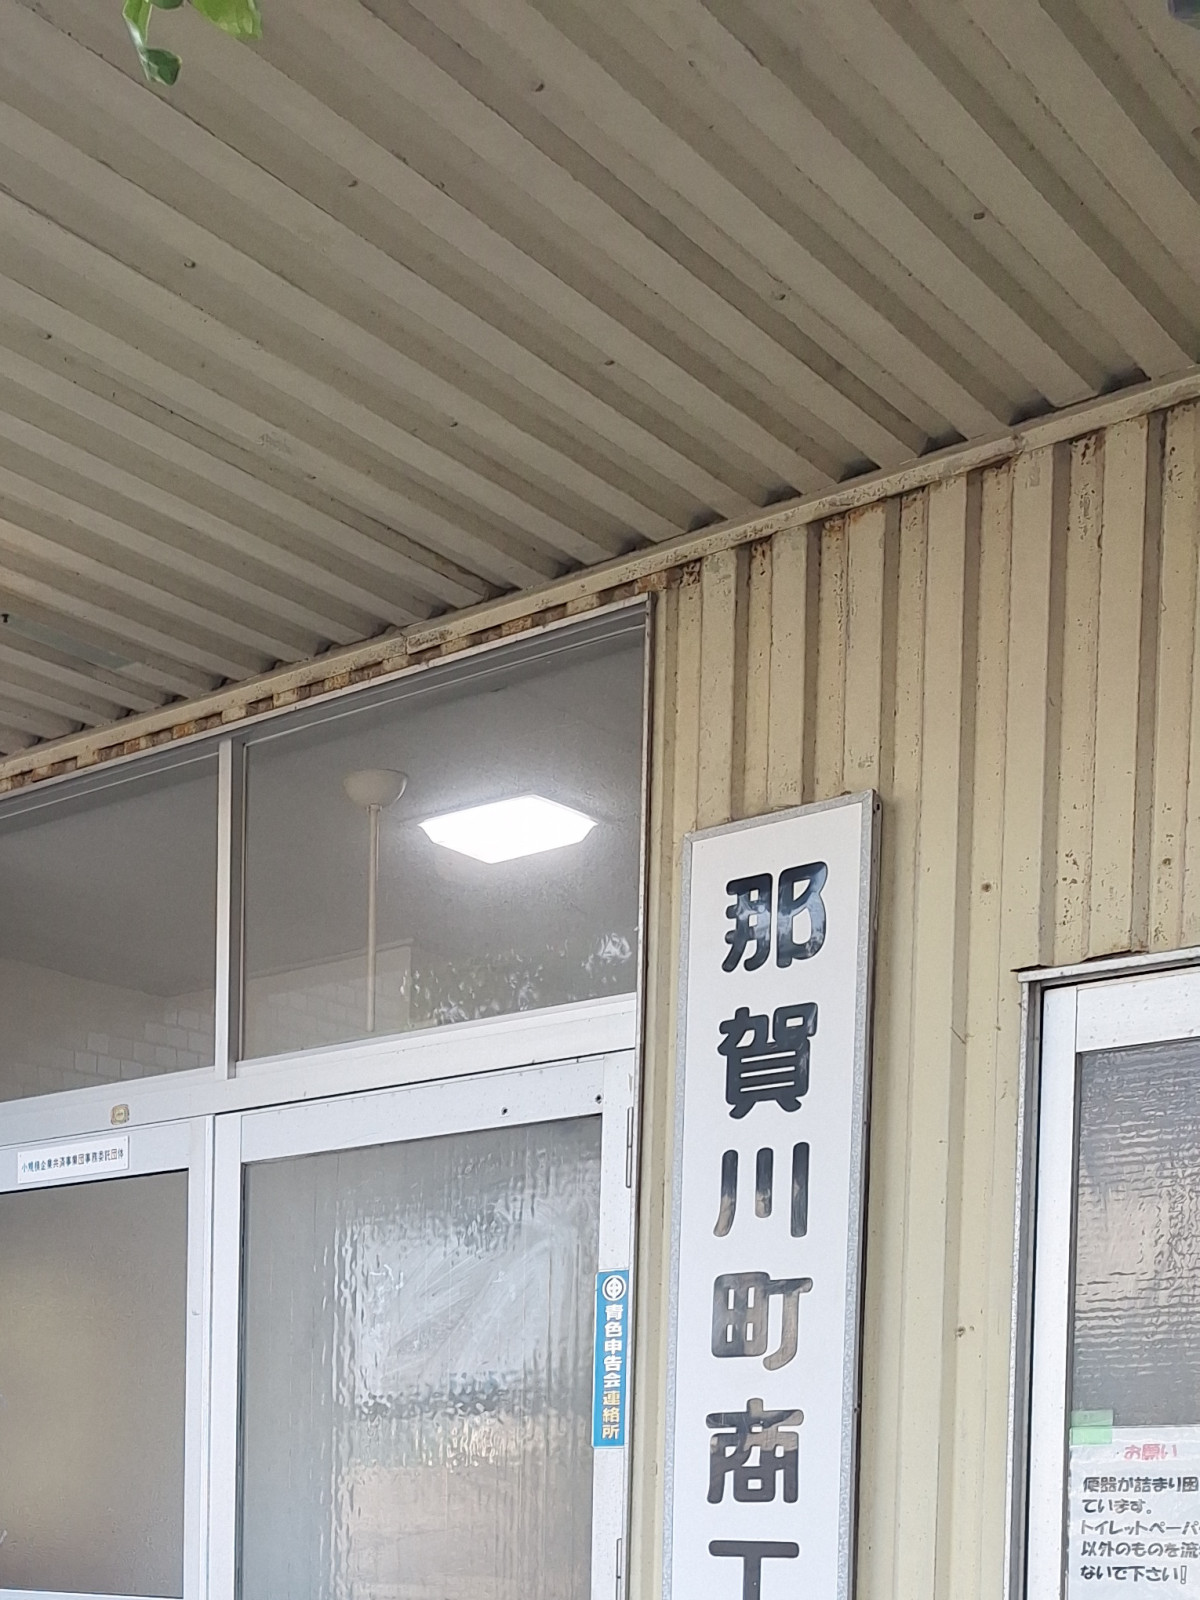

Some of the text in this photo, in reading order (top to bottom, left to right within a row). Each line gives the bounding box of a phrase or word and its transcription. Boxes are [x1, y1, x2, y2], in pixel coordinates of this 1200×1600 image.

[602, 1304, 624, 1440] 青色申告会連絡所
[1124, 1444, 1178, 1461] お願い
[1083, 1476, 1199, 1493] 便器が詰まり困
[1082, 1499, 1152, 1514] ています。
[1081, 1520, 1200, 1536] トイレットペーパ
[1081, 1541, 1200, 1558] 以外のものを流
[1080, 1565, 1187, 1585] ないで下さい!
